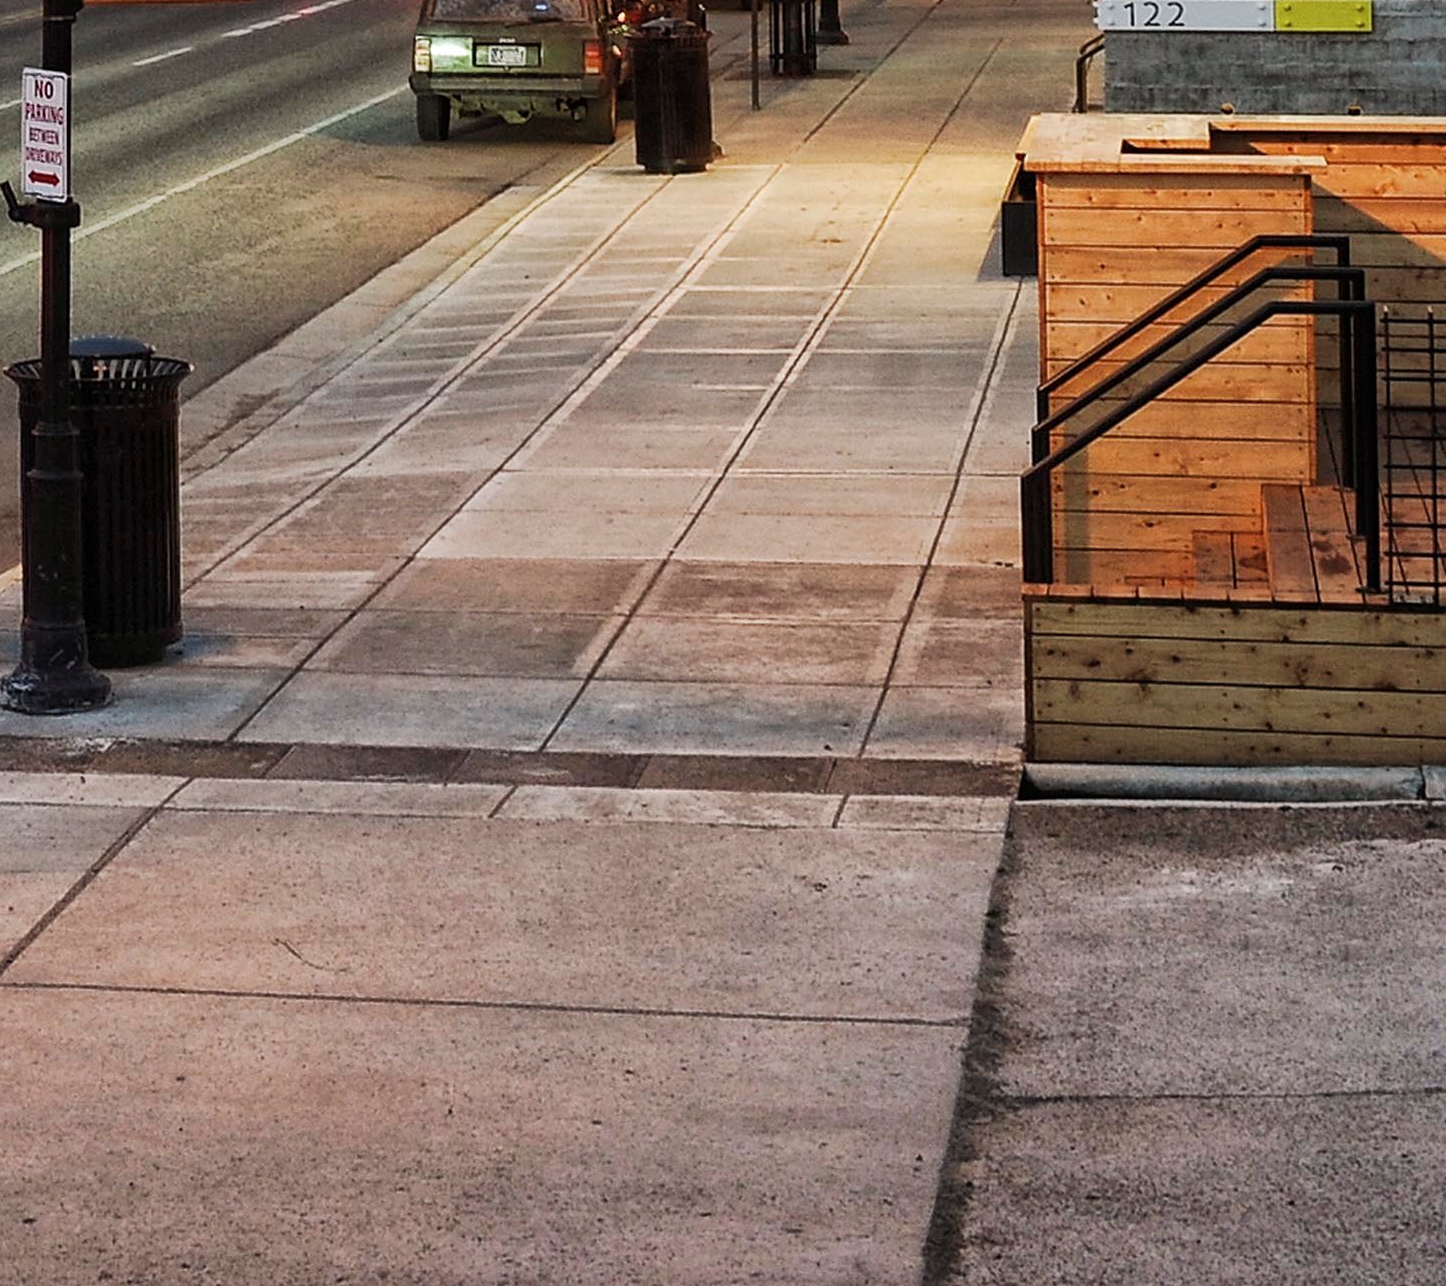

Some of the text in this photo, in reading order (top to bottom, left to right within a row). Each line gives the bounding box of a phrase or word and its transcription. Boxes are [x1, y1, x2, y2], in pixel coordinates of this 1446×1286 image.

[1123, 1, 1186, 27] 122
[34, 79, 55, 99] NO
[24, 102, 65, 126] PARKING
[28, 127, 60, 145] BETWEEN
[24, 147, 63, 166] DRIVEWAYS
